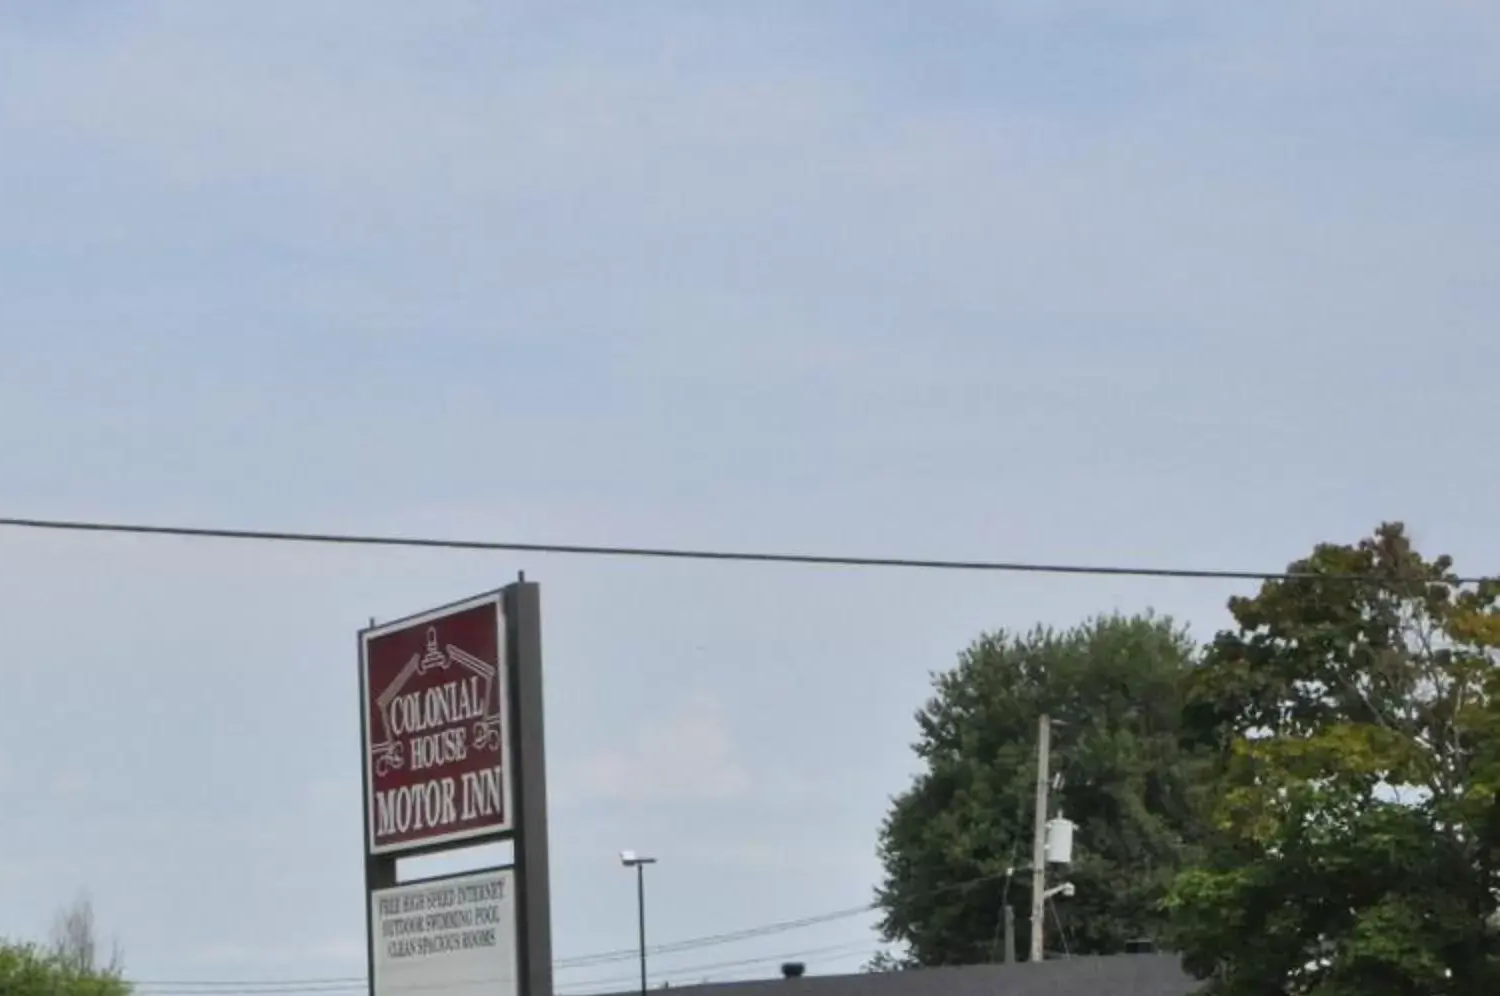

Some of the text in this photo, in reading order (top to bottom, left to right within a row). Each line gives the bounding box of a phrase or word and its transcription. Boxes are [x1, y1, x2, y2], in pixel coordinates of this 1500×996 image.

[390, 676, 485, 735] COLONIAL
[410, 726, 467, 770] HOUSE
[376, 767, 502, 836] MOTOR INN
[380, 881, 505, 916] FREE HIGH SPEED INTERNET
[383, 916, 423, 935] TDOOR
[476, 905, 499, 924] POOL
